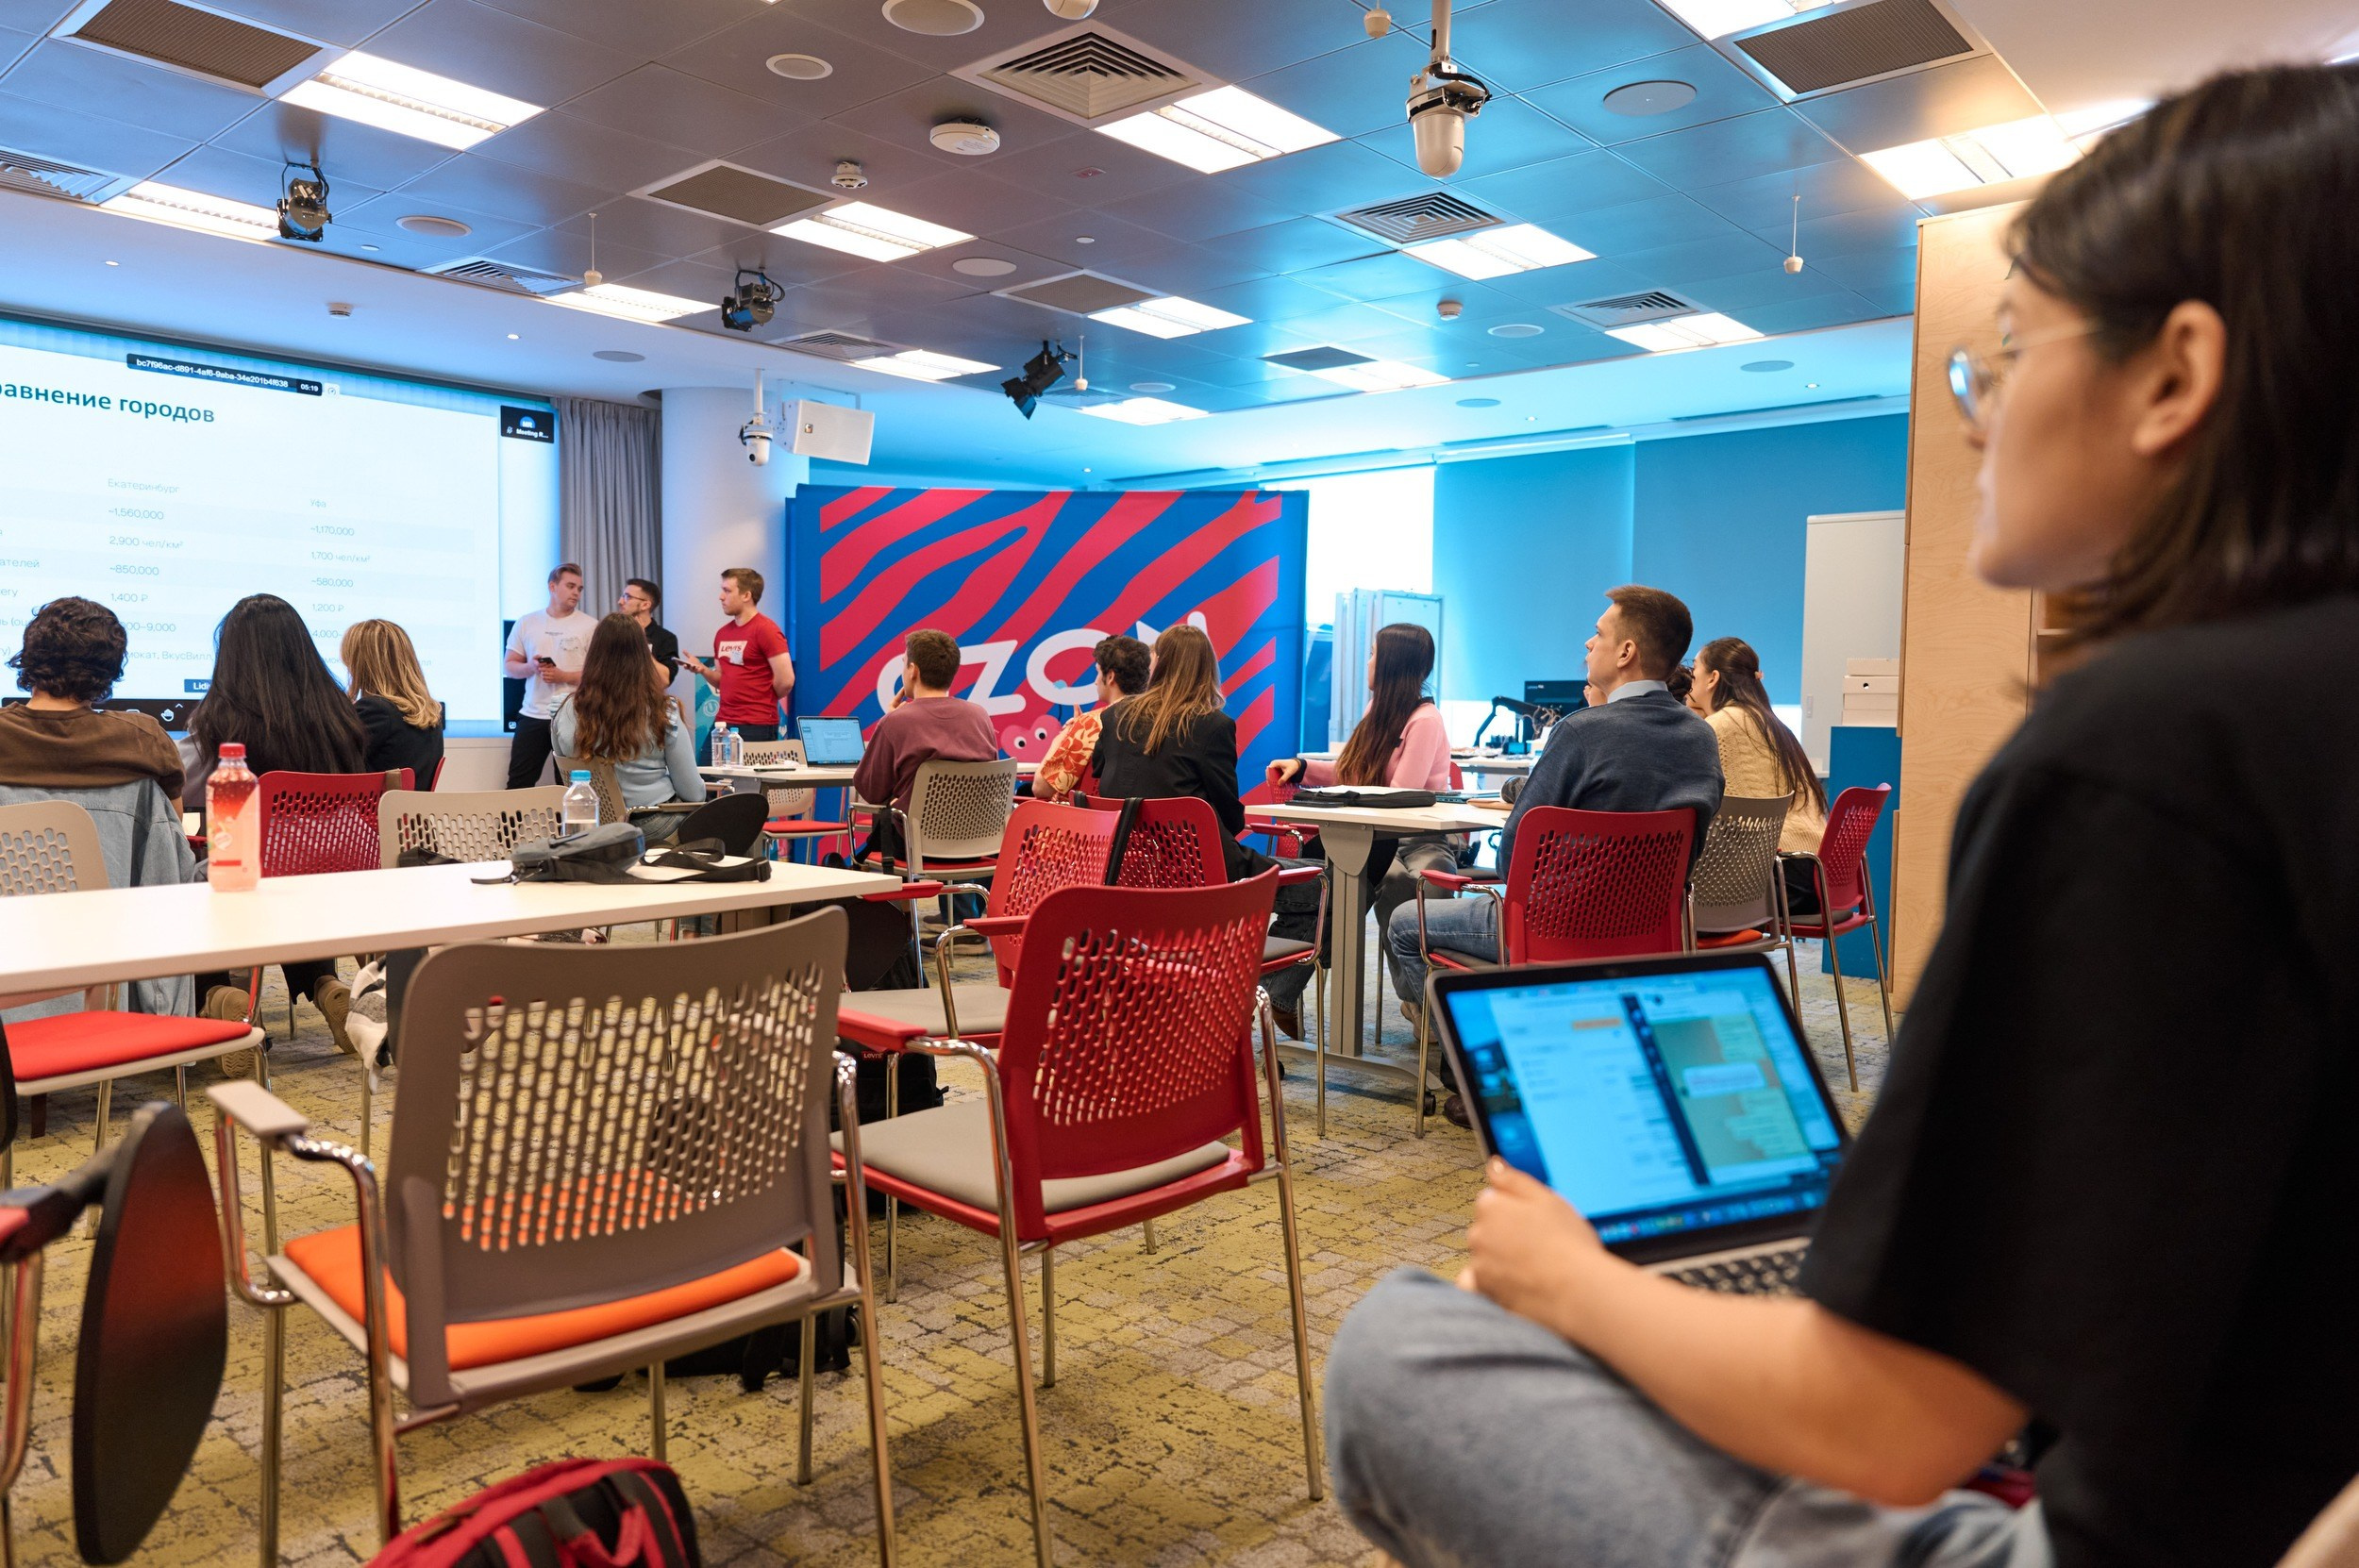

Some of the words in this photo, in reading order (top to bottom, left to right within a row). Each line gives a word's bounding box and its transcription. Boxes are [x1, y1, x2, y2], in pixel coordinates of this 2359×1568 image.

[300, 383, 319, 392] 05:19
[0, 382, 111, 409] авнение
[120, 398, 215, 423] городов
[108, 478, 180, 493] Екатеринбург
